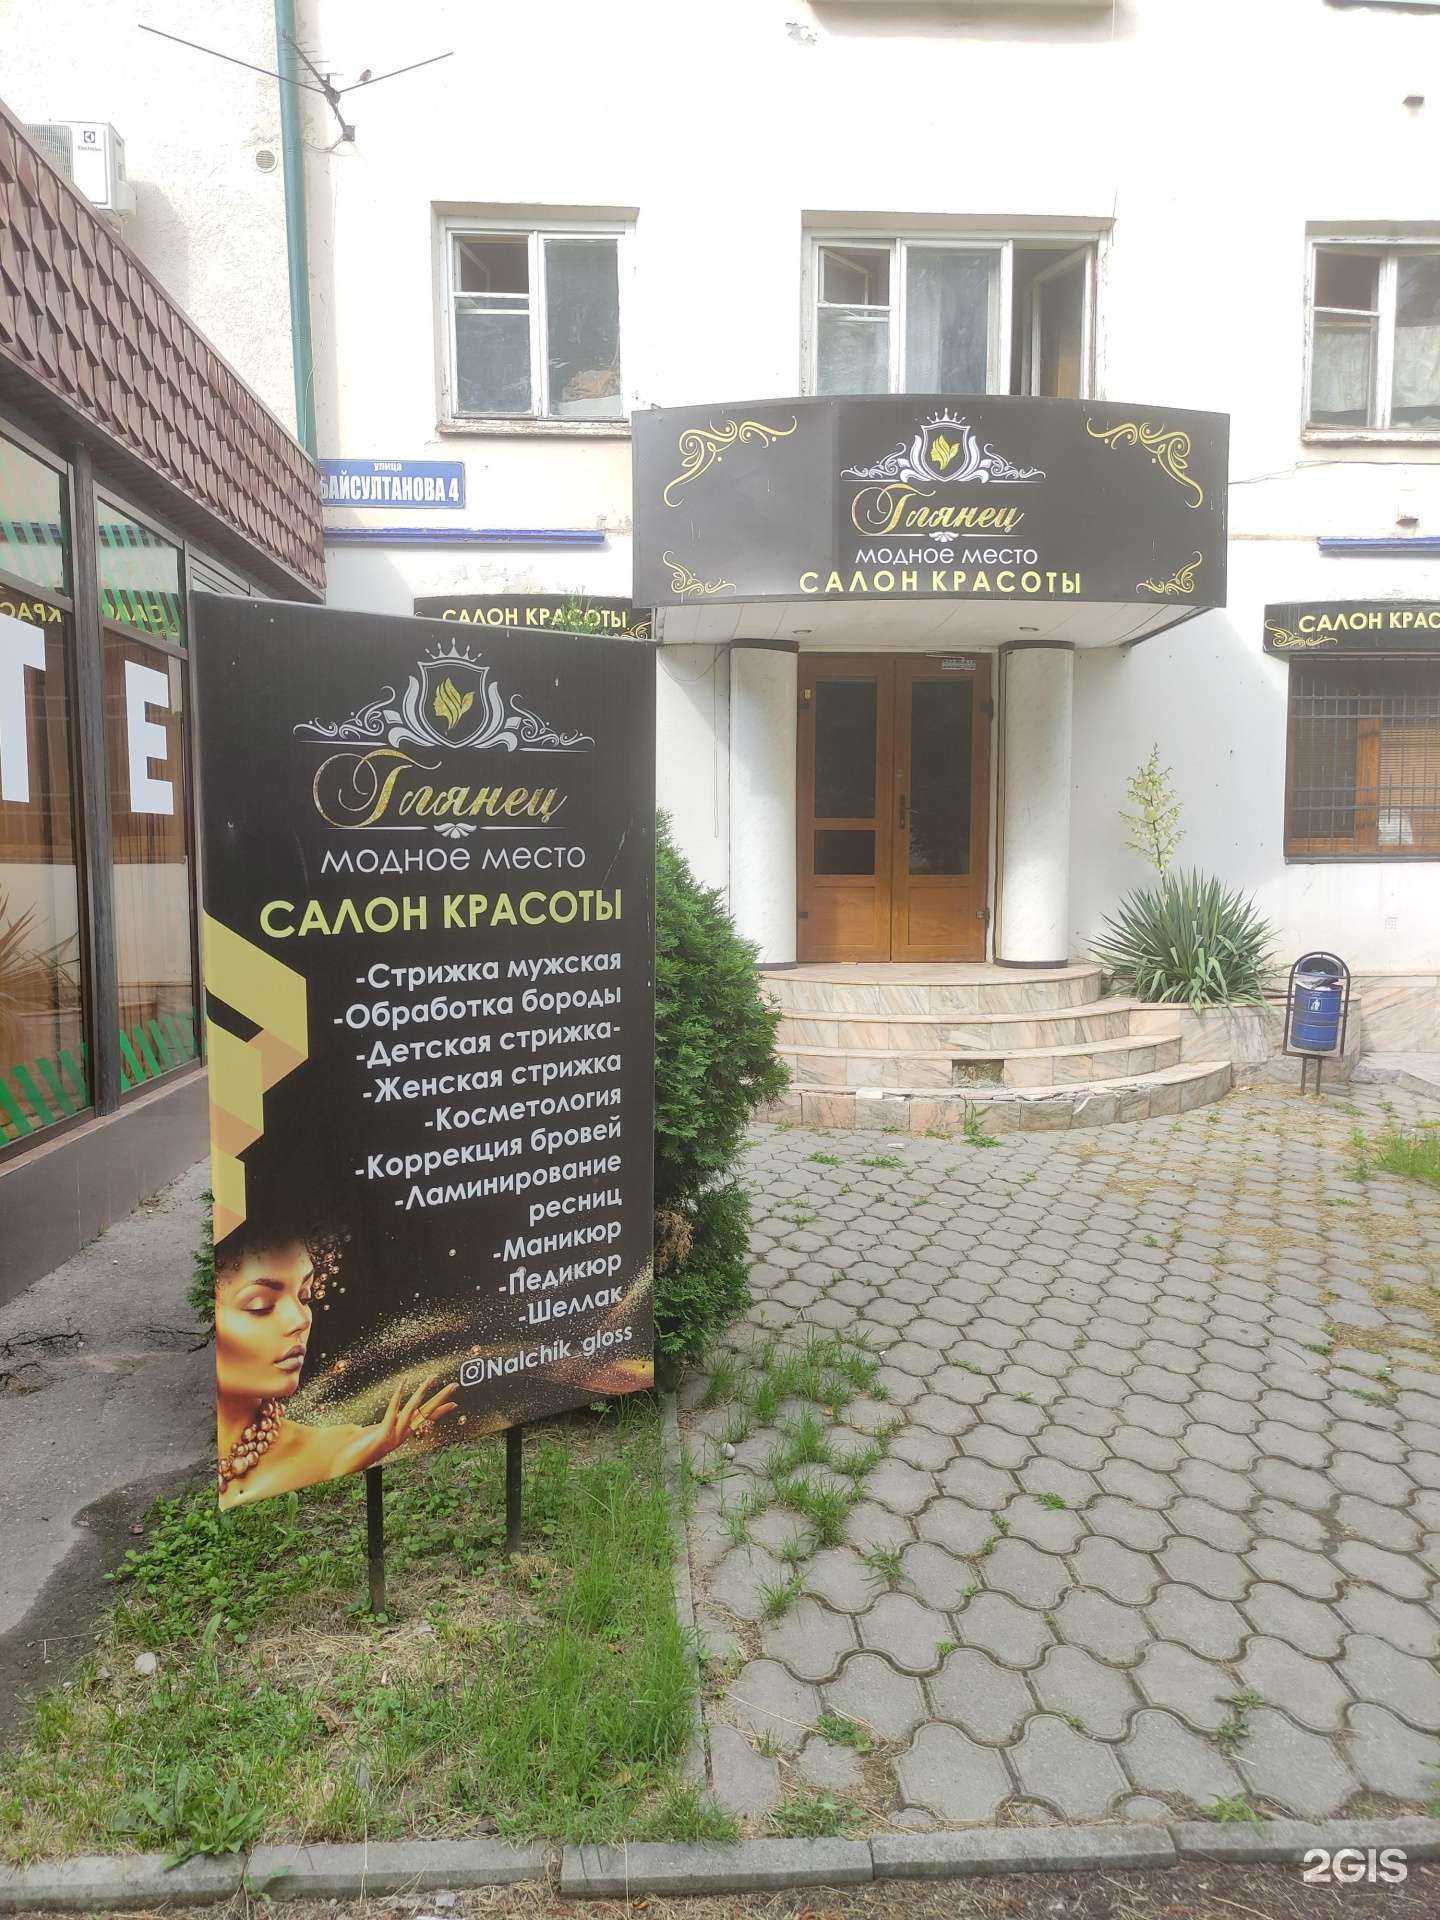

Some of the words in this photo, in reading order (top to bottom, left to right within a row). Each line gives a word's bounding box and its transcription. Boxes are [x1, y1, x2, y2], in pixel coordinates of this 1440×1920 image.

[320, 470, 445, 502] БАЙСУЛТАНОВА
[373, 461, 402, 472] улица
[851, 483, 1024, 536] Глянец
[855, 548, 954, 565] модное
[961, 548, 1038, 565] место
[799, 570, 918, 594] САЛОН
[932, 570, 1081, 594] КРАСОТЫ
[1299, 612, 1382, 633] САЛОН
[312, 748, 568, 828] Глянец
[320, 848, 471, 875] модное
[481, 846, 586, 870] место
[259, 895, 427, 939] САЛОН
[443, 888, 622, 931] КРАСОТЫ
[356, 962, 499, 991] -Стрижка
[507, 952, 621, 982] мужская
[333, 996, 513, 1031] -Обработка
[521, 986, 621, 1015] бороды
[356, 1034, 491, 1069] -Детская
[499, 1020, 621, 1053] стрижка-
[362, 1069, 503, 1103] -Женская
[511, 1054, 621, 1086] стрижка
[424, 1087, 621, 1132] -Косметология
[355, 1137, 522, 1180] -Коррекция
[530, 1115, 621, 1154] бровей
[394, 1154, 622, 1211] -Ламинирование
[529, 1187, 623, 1227] ресниц
[493, 1221, 622, 1262] -Маникюр
[498, 1253, 622, 1296] -Педикюр
[518, 1285, 624, 1325] -Шеллак
